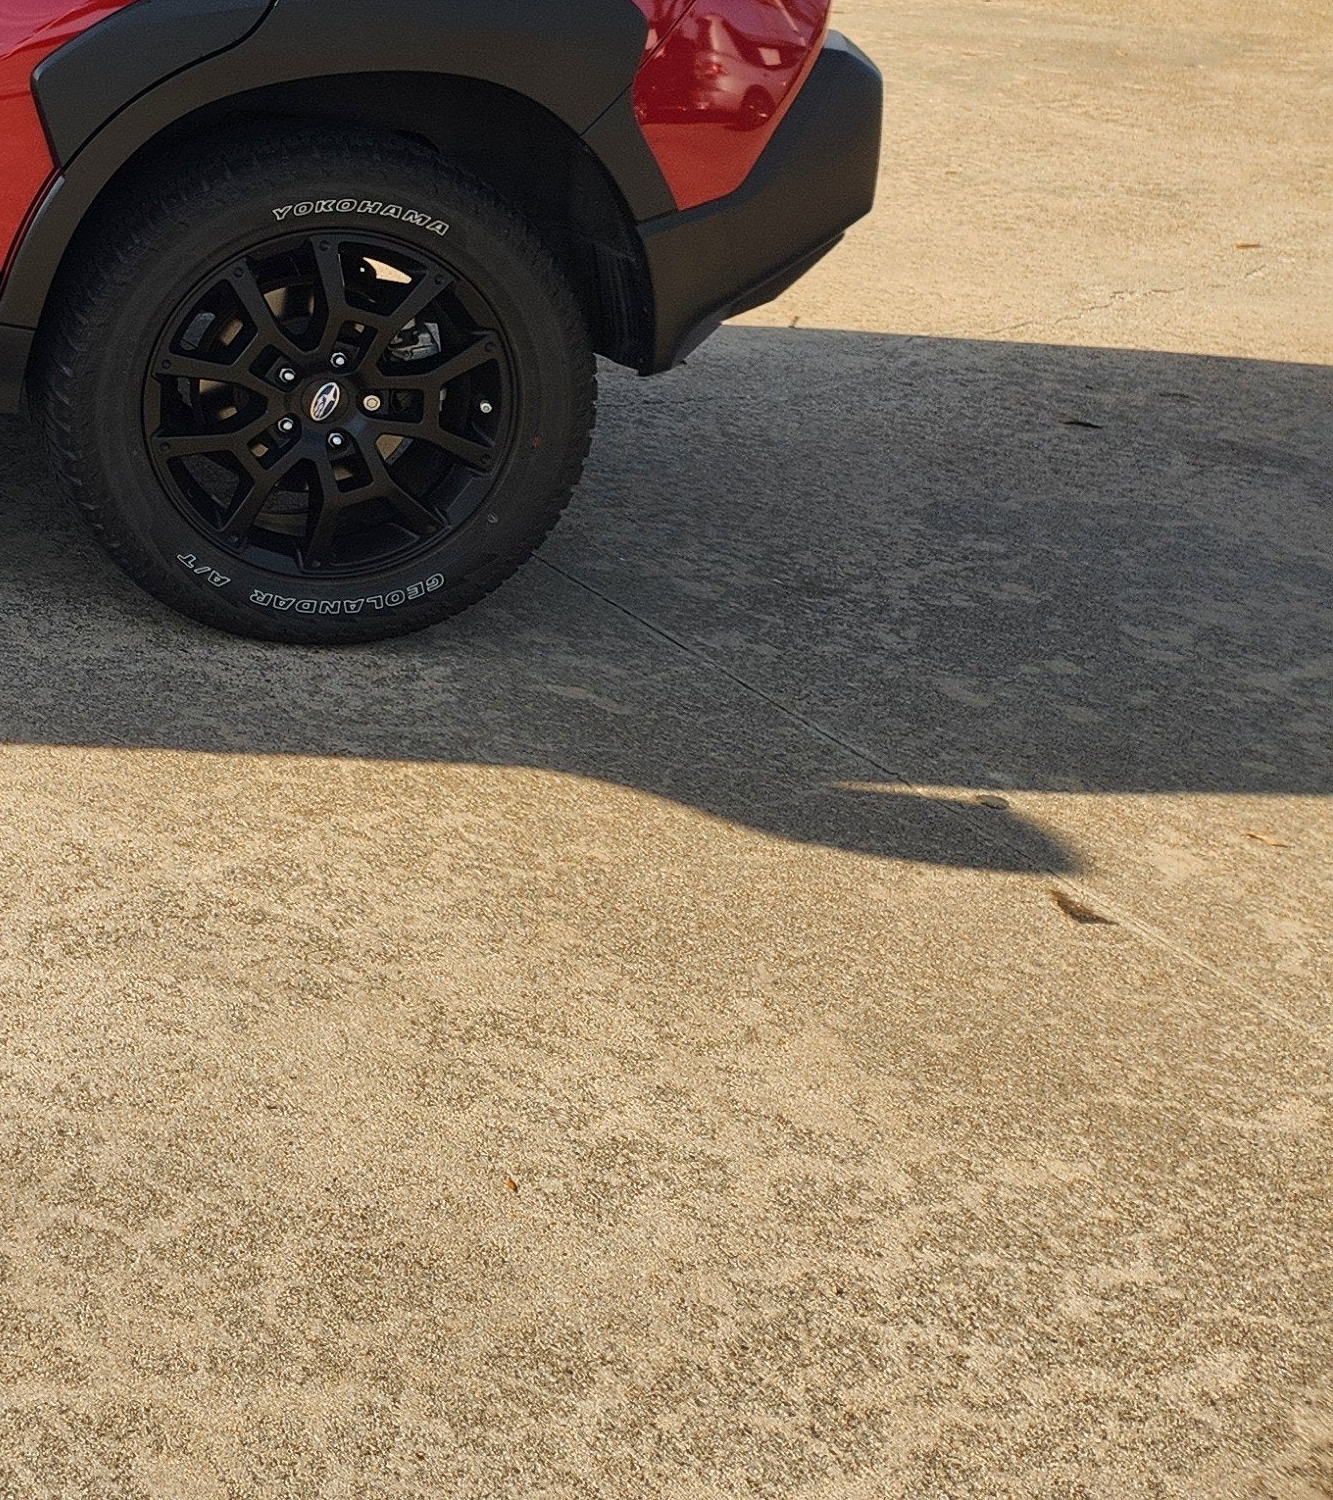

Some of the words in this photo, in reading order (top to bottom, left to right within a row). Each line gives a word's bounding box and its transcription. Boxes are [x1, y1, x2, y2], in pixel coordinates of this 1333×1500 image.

[271, 197, 450, 237] YOKOHAMA
[177, 551, 232, 587] A/T
[248, 572, 445, 615] GEOLANDAR
